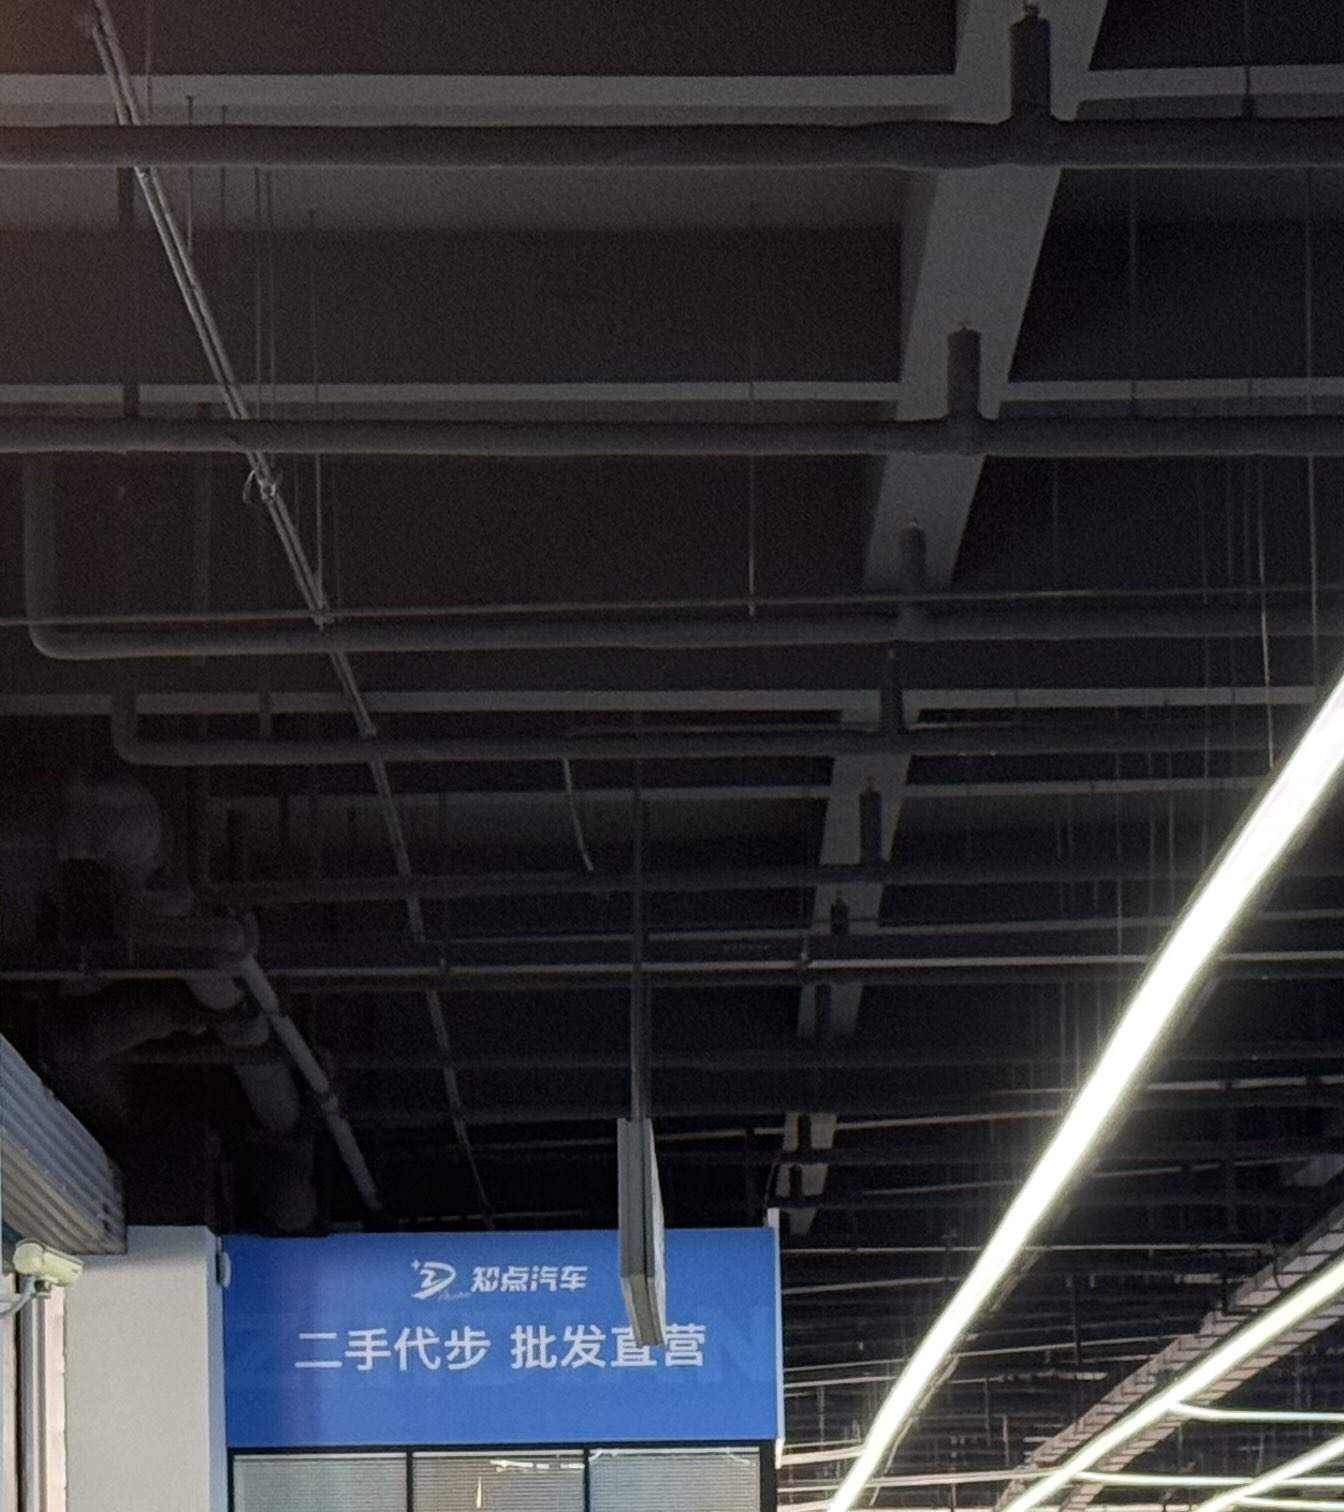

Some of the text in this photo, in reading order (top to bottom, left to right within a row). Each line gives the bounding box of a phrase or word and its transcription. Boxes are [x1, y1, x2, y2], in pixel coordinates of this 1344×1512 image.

[471, 1265, 588, 1293] 知点汽车
[294, 1323, 707, 1371] 二手代步 批发直营
